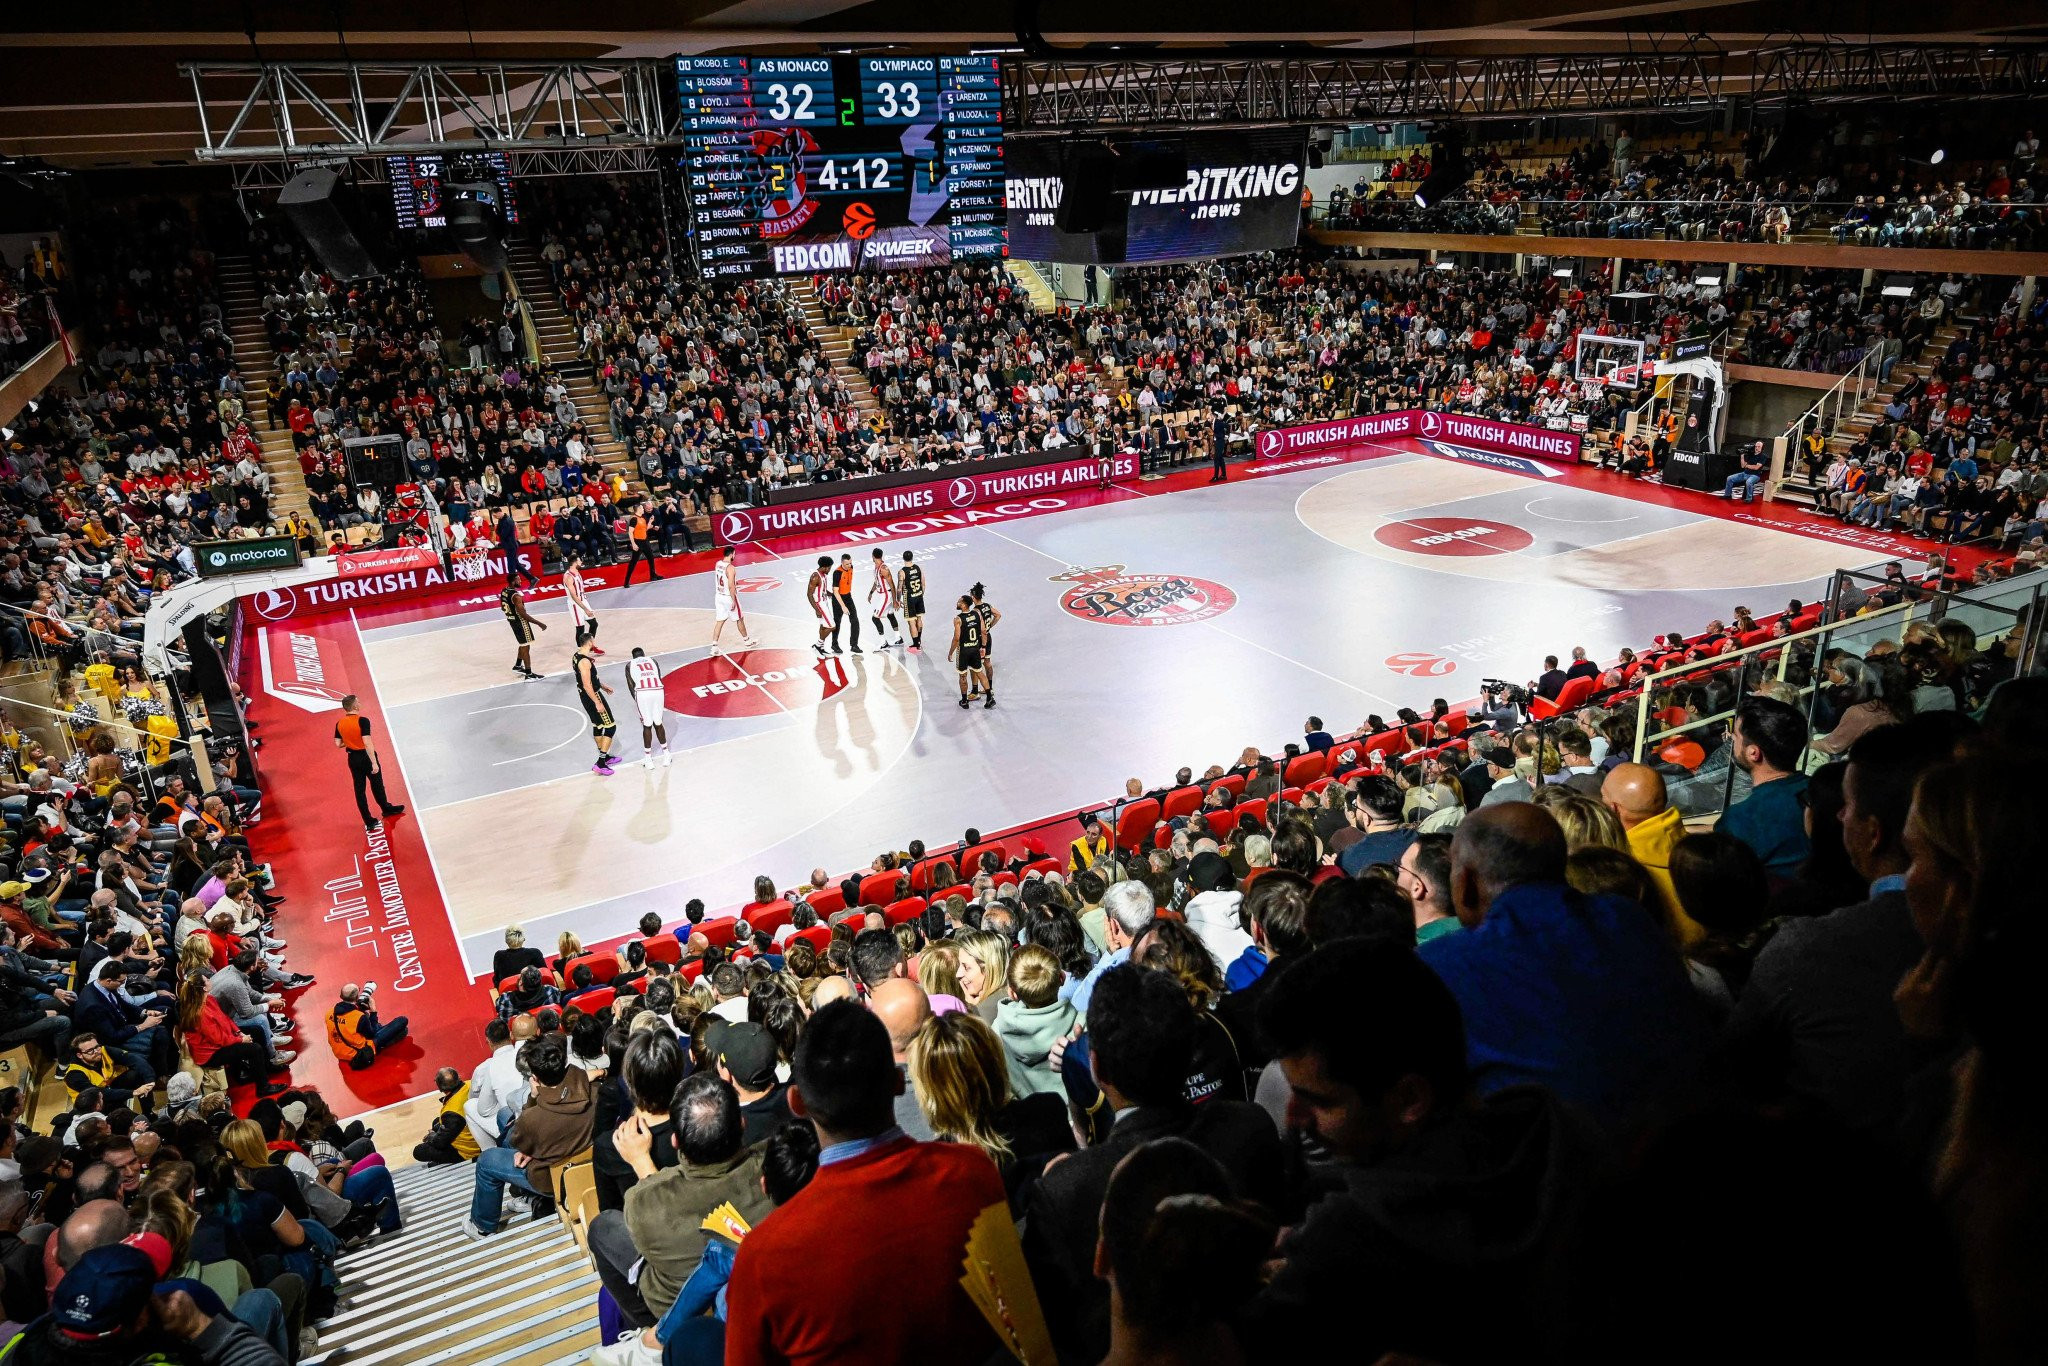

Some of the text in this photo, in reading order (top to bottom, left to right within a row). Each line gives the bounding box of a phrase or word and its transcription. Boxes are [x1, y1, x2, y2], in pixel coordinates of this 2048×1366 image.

[678, 59, 747, 71] 00 OKOBO, E. 4
[759, 60, 829, 72] AS MONACO
[869, 60, 934, 72] OLYMPIACO
[940, 58, 951, 69] 00
[991, 58, 999, 70] 6
[685, 77, 749, 91] 4 BLOSSOM 3
[948, 77, 953, 87] 1
[993, 77, 1000, 87] 4
[688, 98, 696, 109] 8
[702, 98, 724, 107] LOYD,
[743, 97, 751, 108] 4
[767, 83, 816, 121] 32
[877, 82, 921, 118] 33
[947, 92, 988, 104] 5 LARENTZA
[841, 98, 855, 126] 2
[948, 111, 955, 122] 8
[995, 111, 1002, 123] 3
[690, 117, 698, 129] 9
[700, 116, 737, 125] PAPAGIAN
[947, 129, 956, 140] 10
[961, 128, 979, 137] FALL,
[690, 137, 701, 148] 11
[703, 136, 731, 145] DIALLO,
[948, 144, 1004, 158] 14 VEZENKOV 5
[693, 156, 702, 168] 12
[950, 162, 991, 175] 16 PAPANIKO
[419, 163, 438, 177] 32
[818, 157, 890, 191] 4:12
[929, 160, 934, 182] 1
[692, 172, 743, 186] 20 MOTIEJUN
[771, 164, 785, 191] 2
[948, 182, 959, 193] 22
[960, 180, 988, 189] DORSEY,
[422, 190, 428, 200] 2
[695, 194, 707, 205] 22
[950, 198, 961, 209] 25
[961, 197, 987, 206] PETERS,
[697, 211, 710, 223] 23
[1190, 203, 1241, 220] .news
[764, 206, 811, 234] BASKET
[951, 213, 995, 226] 33 MILUTINOV
[1025, 212, 1055, 226] .news
[700, 230, 712, 241] 30
[712, 228, 742, 238] BROWN,
[743, 227, 750, 236] VI
[701, 249, 713, 260] 32
[864, 239, 935, 258] SKWEEK
[952, 249, 964, 259] 94
[1002, 245, 1010, 257] 8
[773, 242, 852, 273] FEDCOM
[703, 267, 716, 279] 55
[718, 265, 744, 275] JAMES,
[1287, 416, 1409, 448] TURKISH AIRLINES
[1445, 420, 1572, 456] TURKISH AIRLINES
[1457, 449, 1526, 470] motorola
[1674, 452, 1700, 465] FEDCOM
[981, 470, 1057, 496] TURKISH
[759, 489, 934, 531] TURKISH AIRLINES
[840, 498, 1067, 542] MONACO
[1410, 526, 1499, 547] FEDCOM
[230, 547, 287, 562] motorola
[358, 554, 419, 569] TURKISH AIRLINES
[304, 570, 417, 605] TURKISH
[910, 579, 921, 592] 55
[969, 628, 977, 641] 0
[637, 662, 654, 672] 10
[1189, 1078, 1223, 1098] PASTOR
